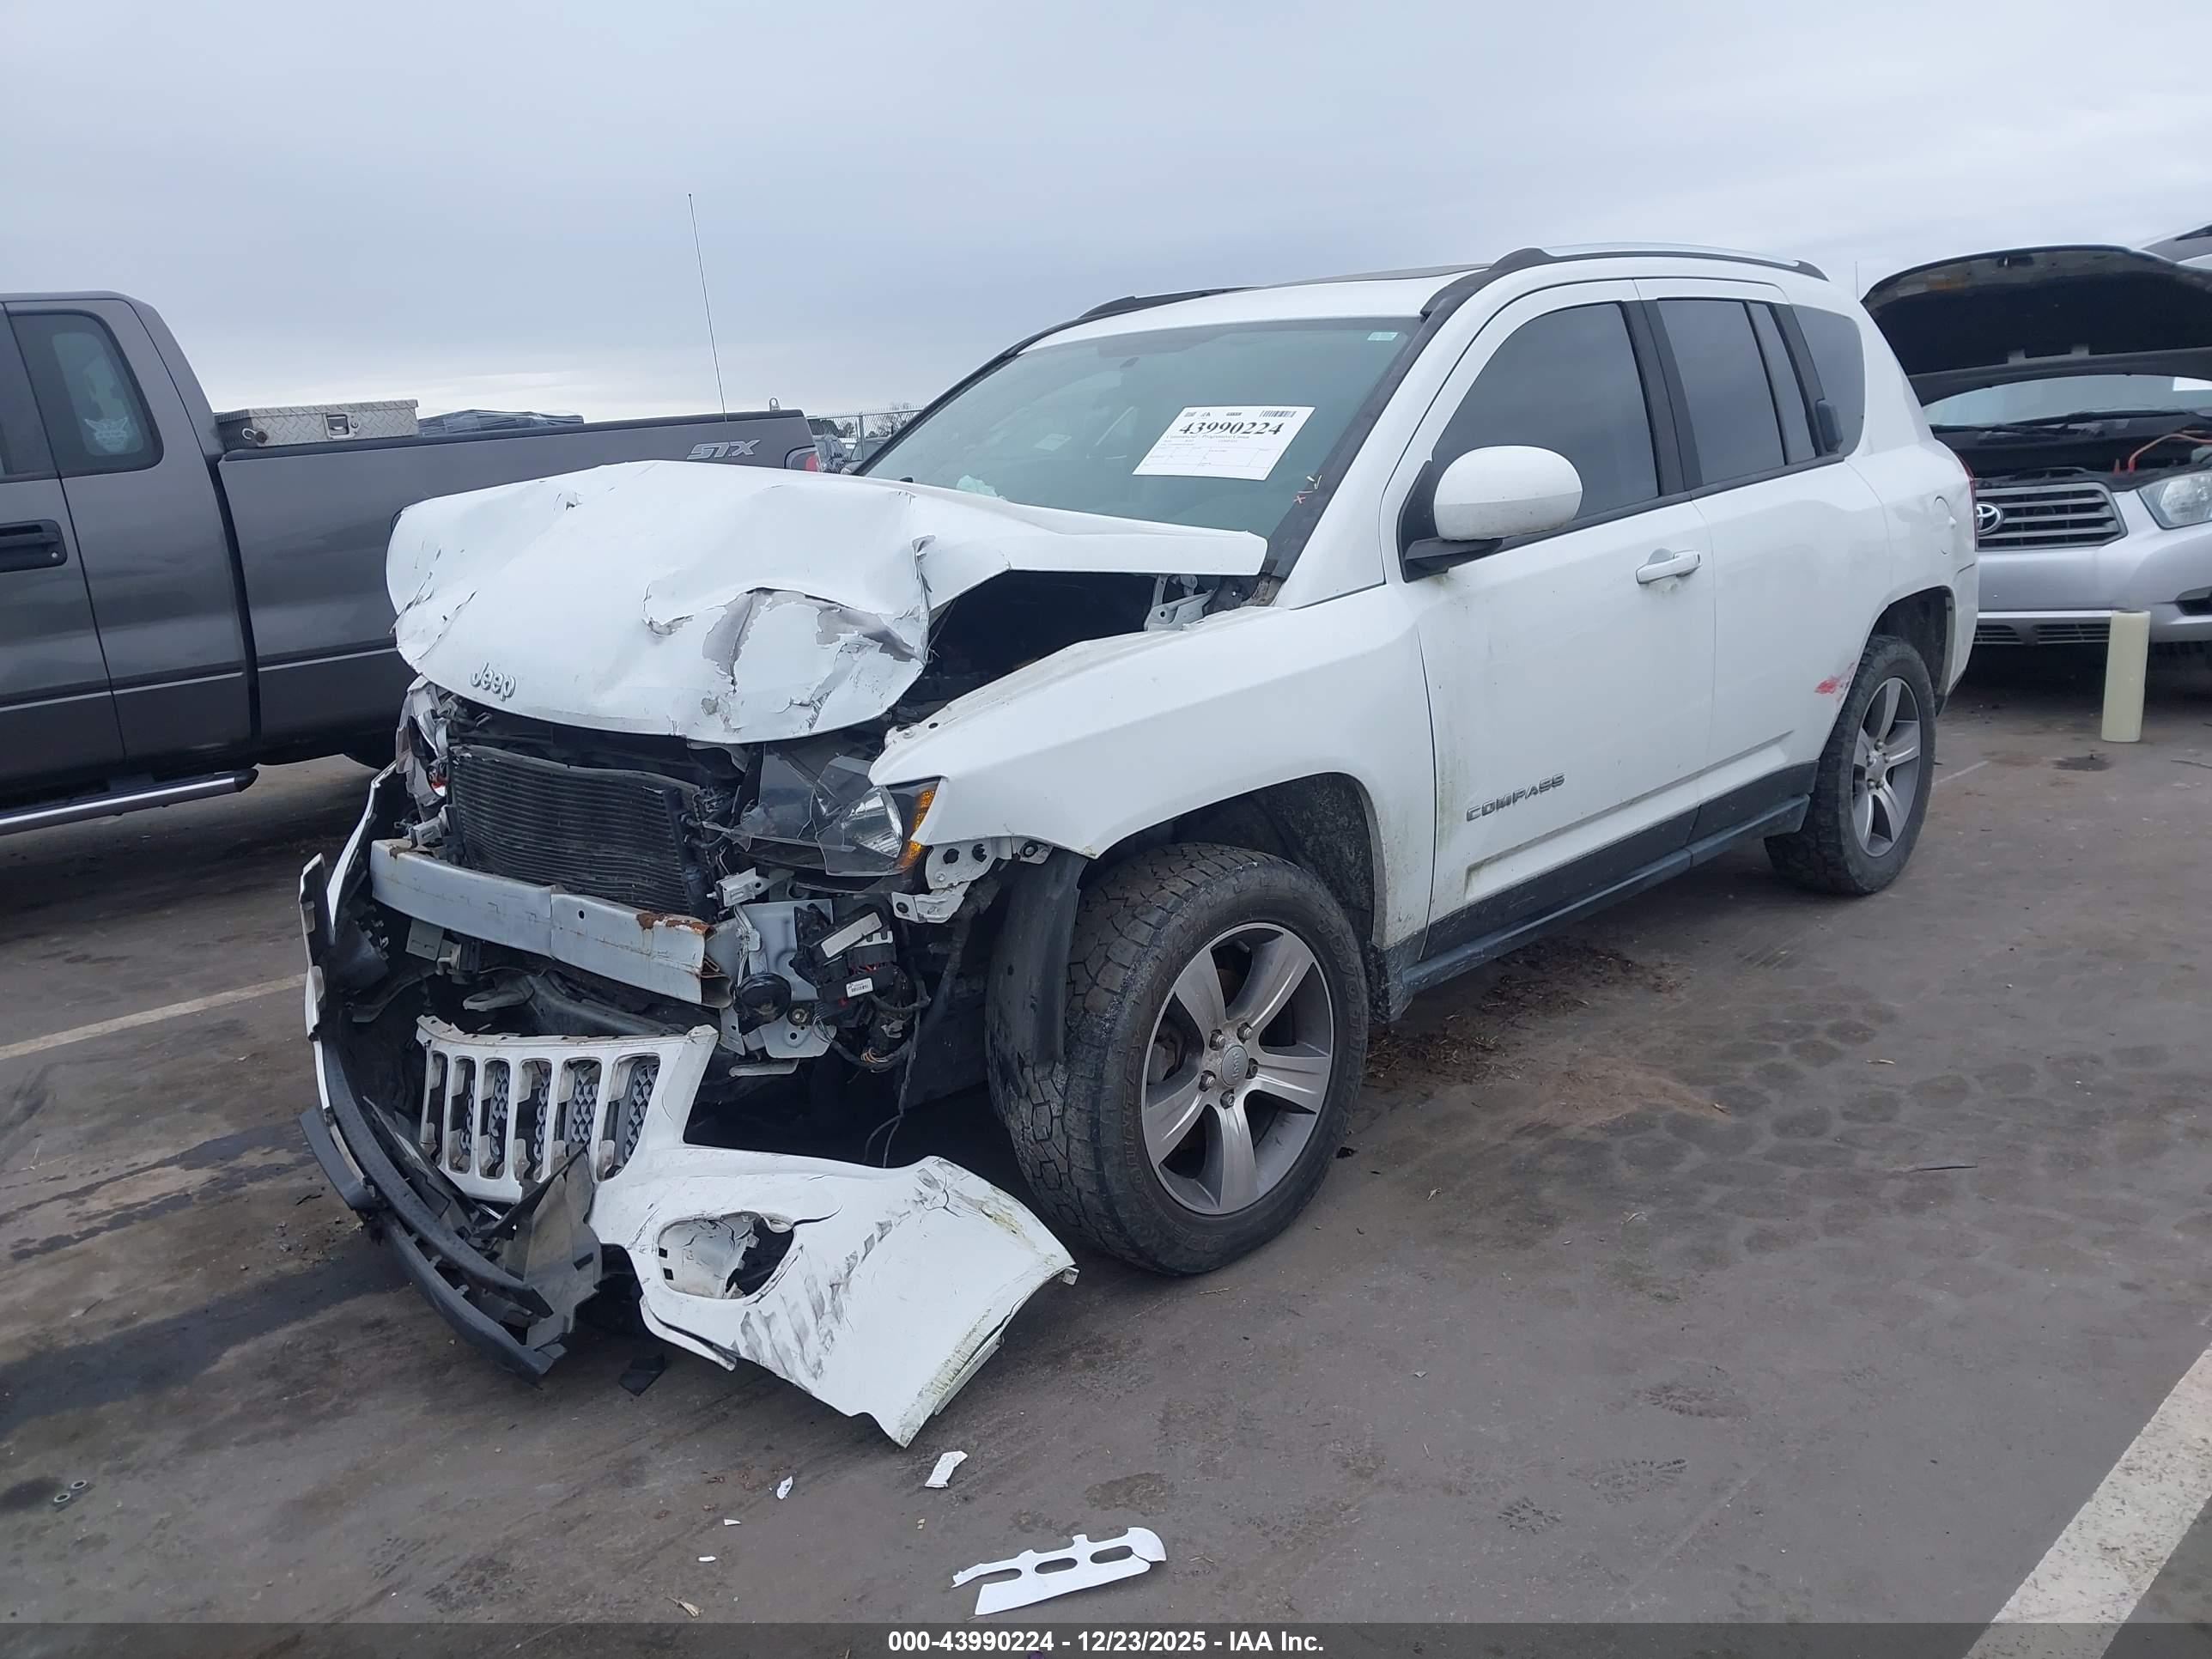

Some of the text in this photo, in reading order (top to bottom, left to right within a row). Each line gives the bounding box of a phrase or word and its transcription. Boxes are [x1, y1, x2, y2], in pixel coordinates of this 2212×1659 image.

[1179, 421, 1285, 435] 43990224
[687, 439, 761, 460] STX
[470, 661, 517, 702] Jeep
[1466, 772, 1566, 823] COMPASS
